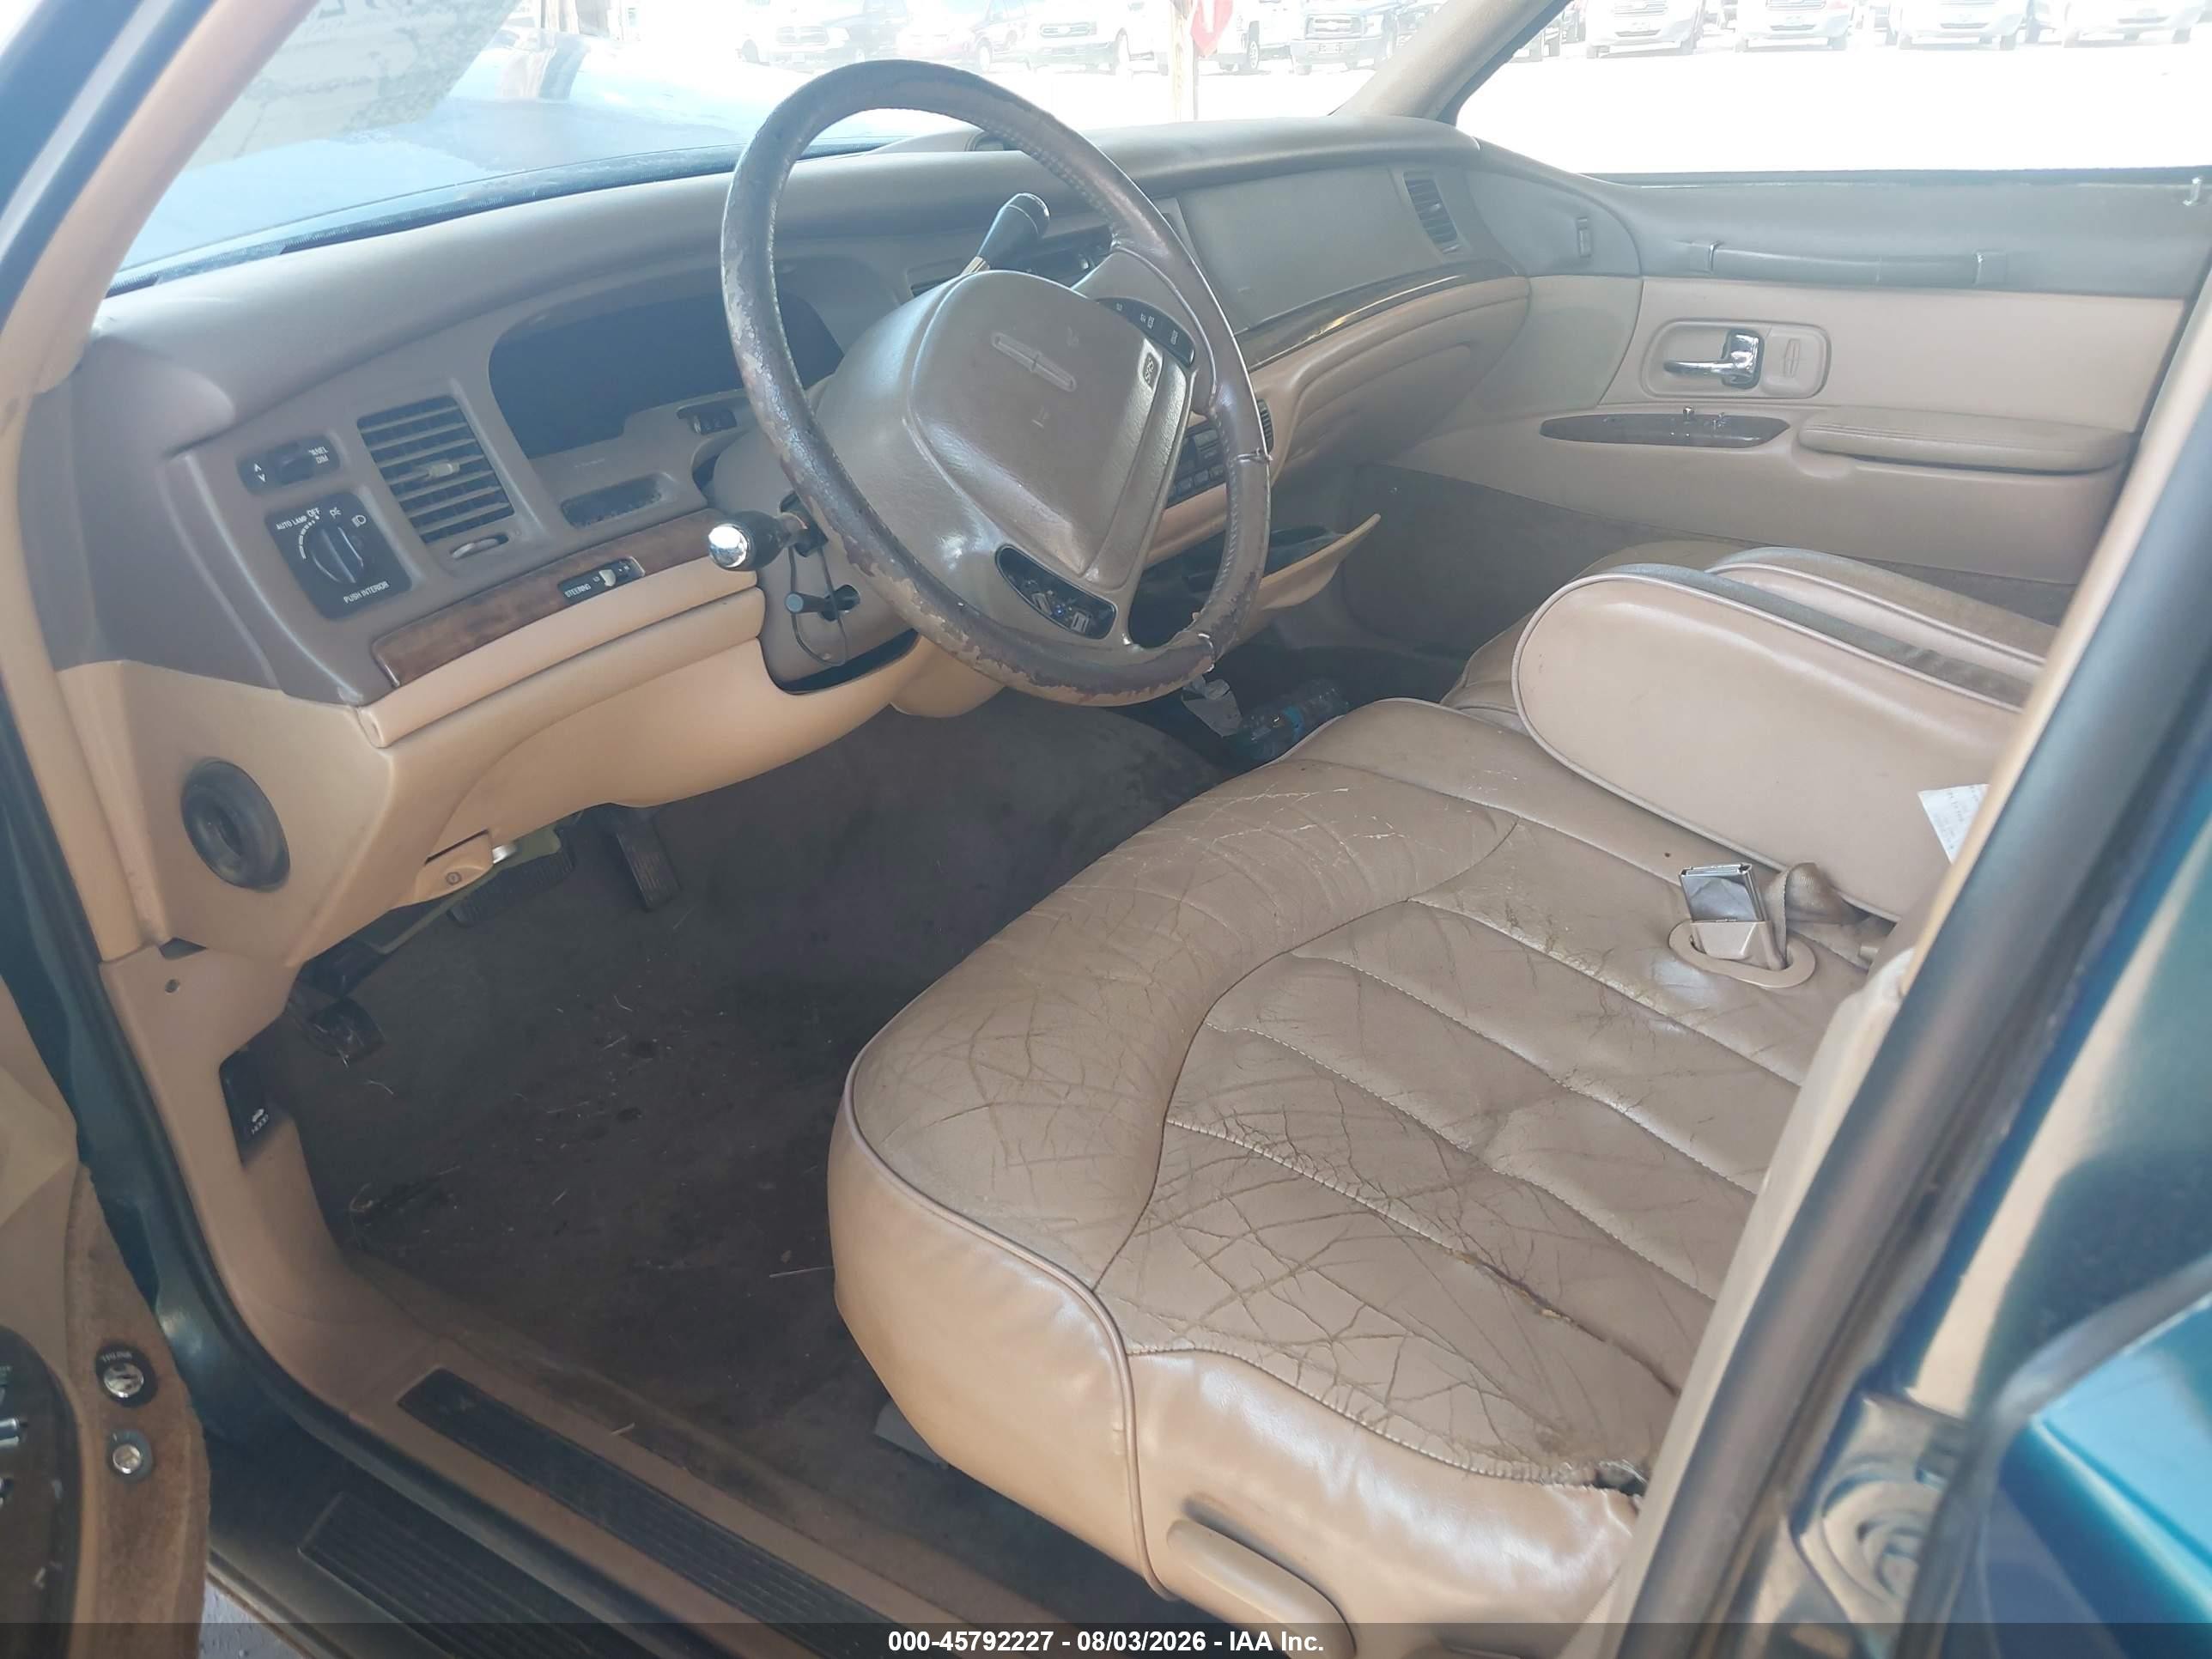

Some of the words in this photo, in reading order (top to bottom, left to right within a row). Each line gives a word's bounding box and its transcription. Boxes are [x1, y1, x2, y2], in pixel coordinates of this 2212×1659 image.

[276, 521, 292, 530] AUTO
[293, 515, 307, 525] LAMP
[307, 507, 320, 517] OFF
[343, 591, 362, 603] PUSH
[362, 580, 389, 597] INTERIOR
[565, 584, 591, 598] STEERING
